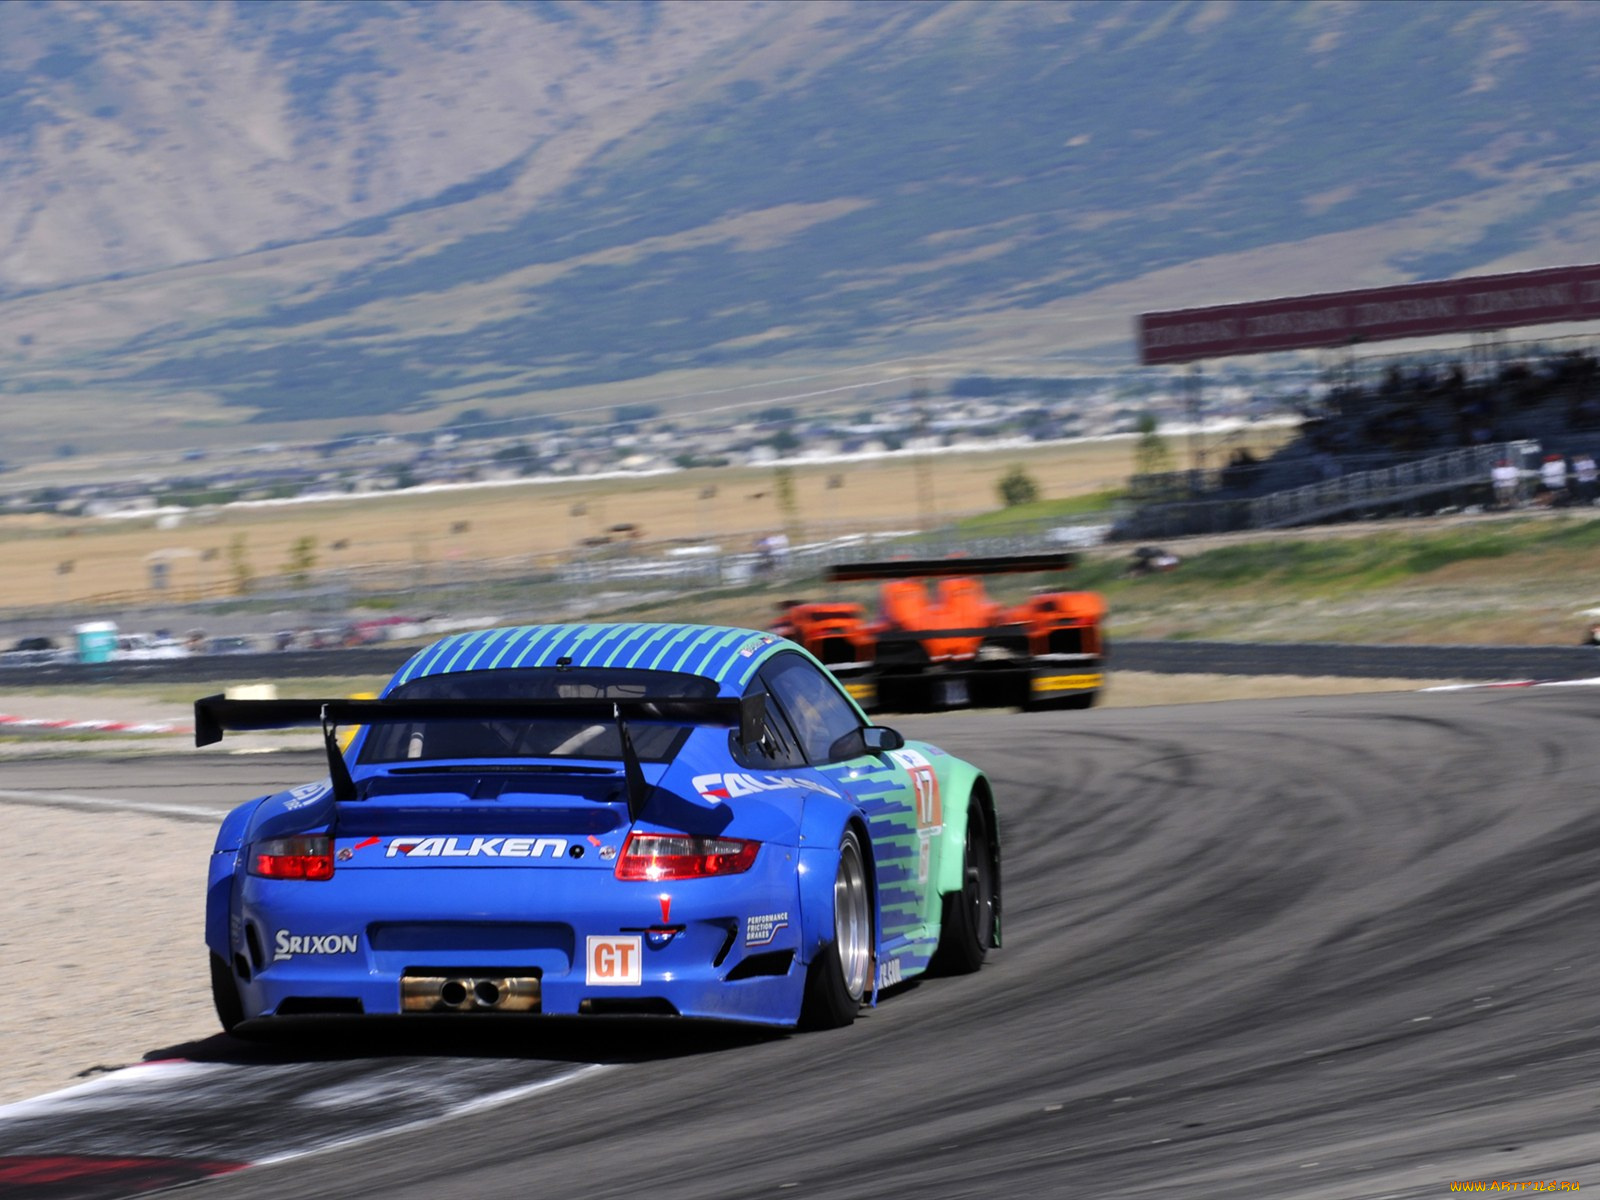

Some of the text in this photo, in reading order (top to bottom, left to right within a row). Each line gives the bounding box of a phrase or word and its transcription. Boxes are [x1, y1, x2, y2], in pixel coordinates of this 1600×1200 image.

[914, 769, 933, 823] 17
[384, 837, 568, 858] FALKEN
[747, 912, 788, 924] PERFORMANCE
[746, 930, 769, 940] BRAKES
[747, 922, 773, 932] FRICTION
[594, 943, 635, 977] GT
